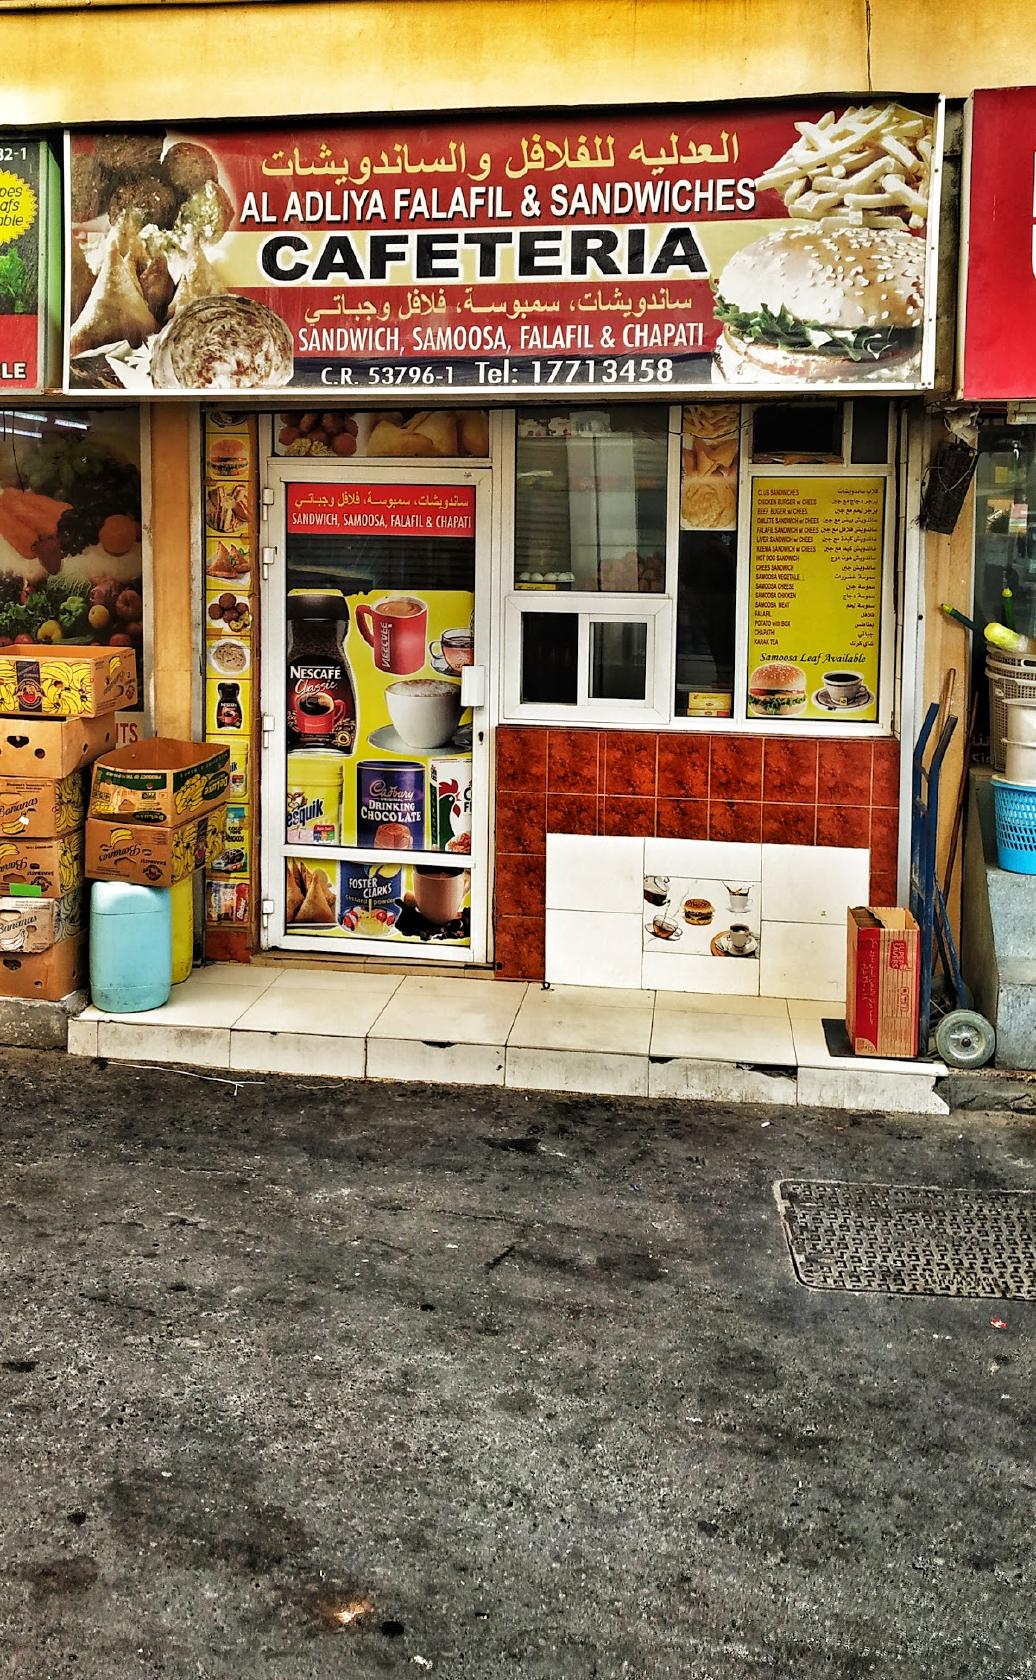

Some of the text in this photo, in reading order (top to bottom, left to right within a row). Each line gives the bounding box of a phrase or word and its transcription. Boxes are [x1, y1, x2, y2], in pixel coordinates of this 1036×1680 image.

[505, 132, 615, 179] للفلافل
[240, 177, 756, 223] AL ADLIYA FALAFIL & SANDWICHES
[262, 226, 709, 281] CAFETERIA
[398, 287, 447, 320] فلافل
[299, 322, 704, 356] SANDWICH, SAMOOSA, FALAFIL & CHAPATI
[321, 358, 673, 385] C.R. 53796-1 Tel: 17713458
[337, 490, 361, 508] فلافل
[292, 512, 471, 529] SANDWICH, SAMOOSA, FALAFIL & CHAPATI
[759, 652, 866, 665] Samoosa Leaf Available
[295, 679, 338, 694] Classic
[369, 779, 415, 802] Cadbury
[361, 806, 422, 823] CHOCOLATE
[368, 800, 416, 812] DRINKING
[349, 878, 378, 889] FOSTER
